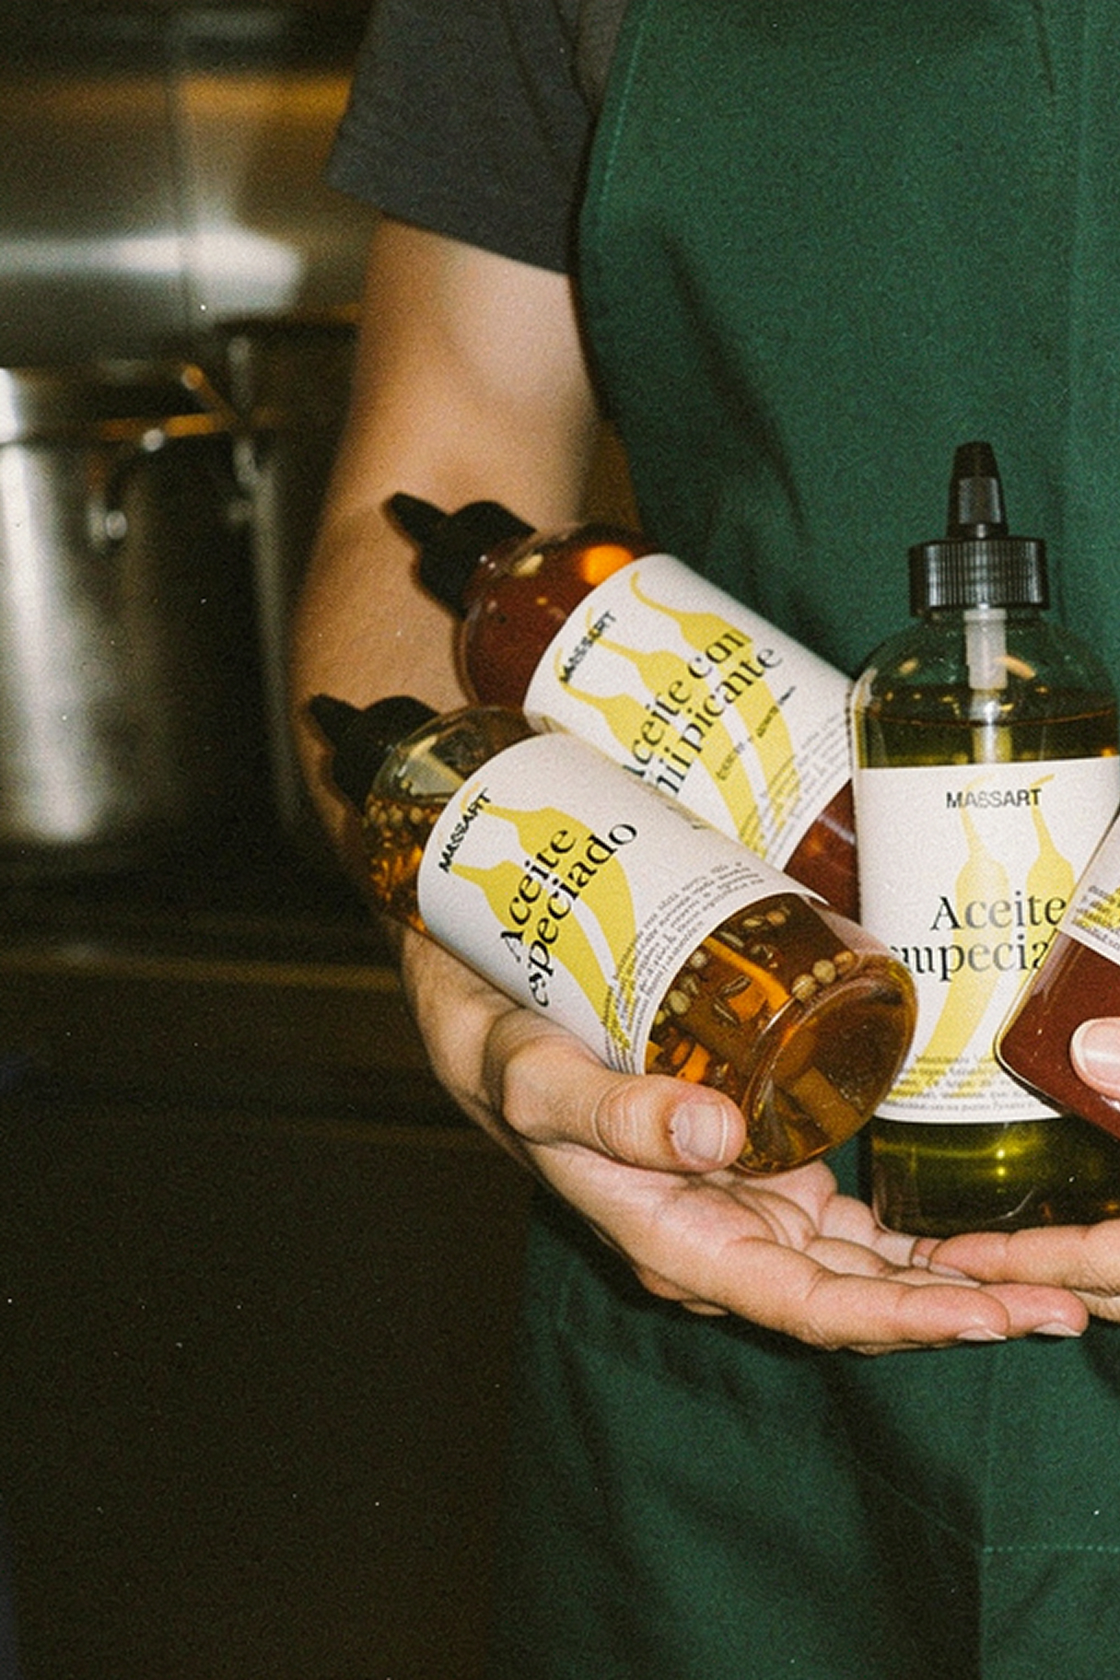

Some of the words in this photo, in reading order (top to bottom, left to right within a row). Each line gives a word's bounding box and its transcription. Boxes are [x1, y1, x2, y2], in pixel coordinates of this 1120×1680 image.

[685, 648, 784, 753] picante
[946, 788, 1042, 809] MASSART
[501, 828, 577, 963] Aceite
[930, 890, 1066, 931] Aceite
